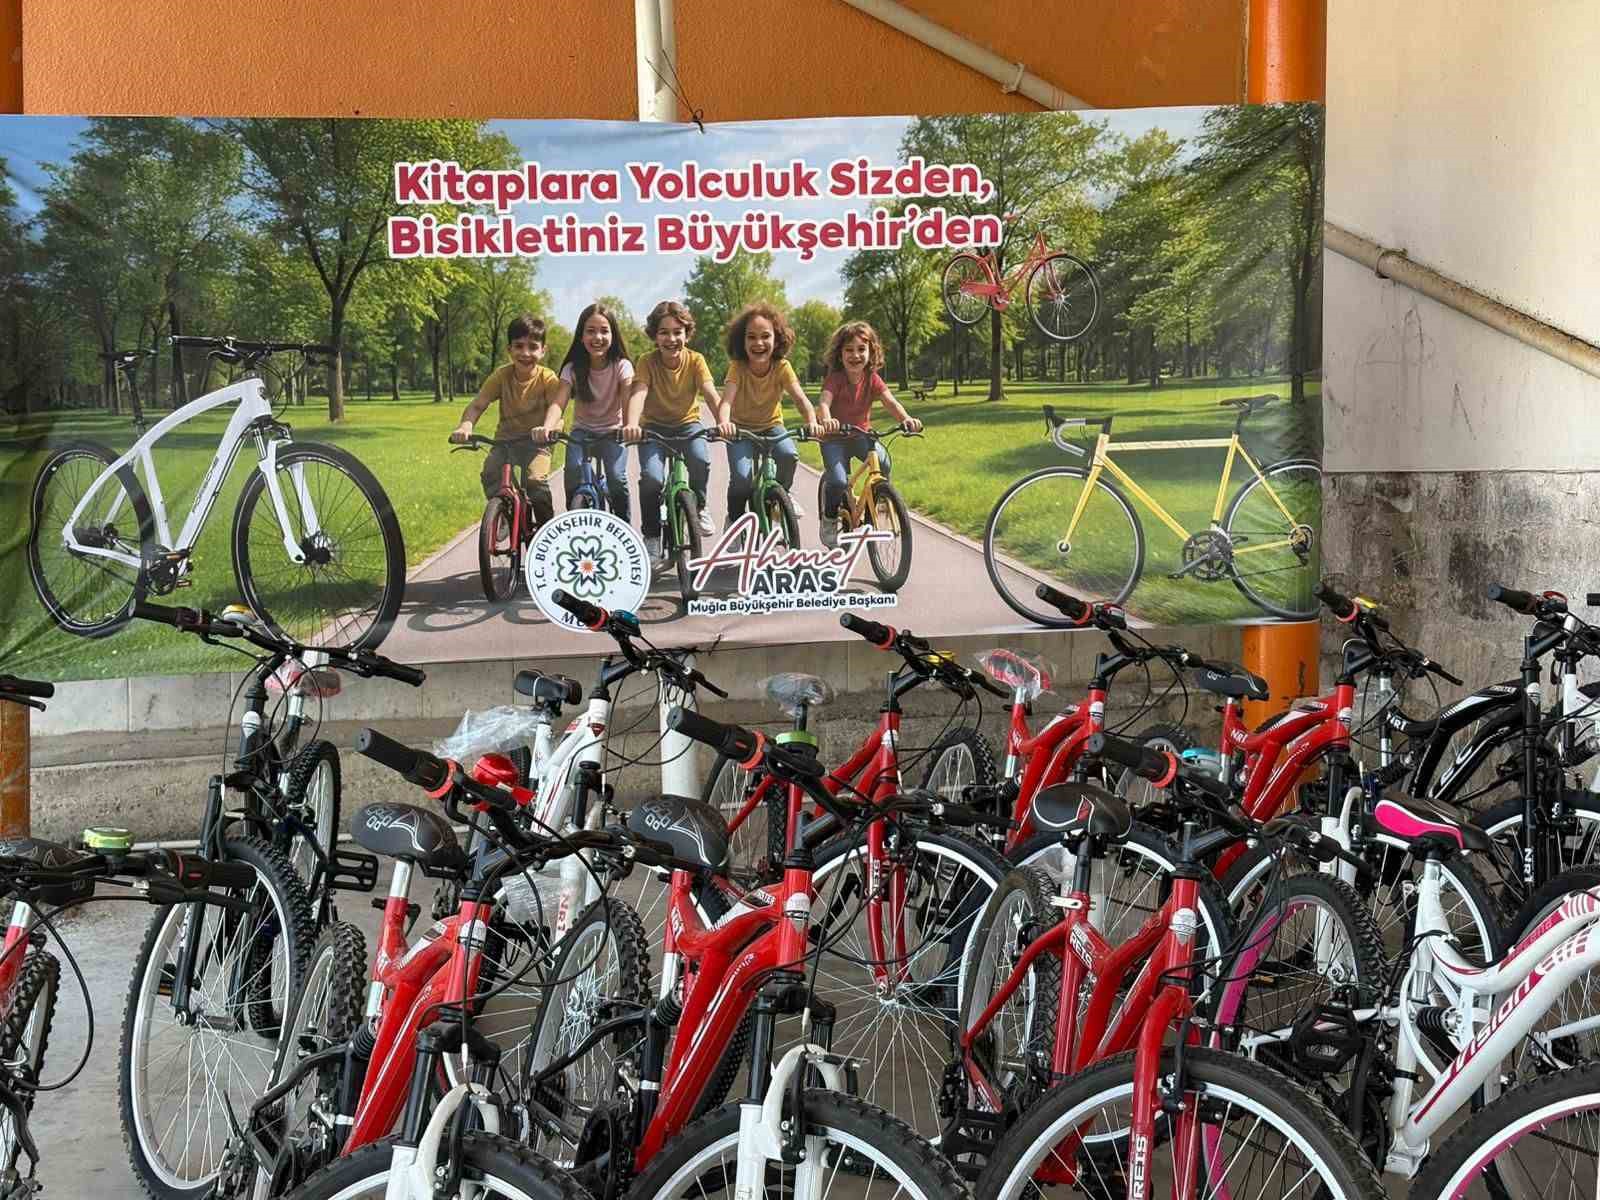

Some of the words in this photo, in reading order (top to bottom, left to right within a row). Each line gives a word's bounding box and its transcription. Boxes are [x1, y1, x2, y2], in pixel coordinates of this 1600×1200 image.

[397, 161, 619, 210] Kitaplara
[629, 160, 818, 199] Yolculuk
[829, 158, 991, 197] Sizden,
[391, 215, 645, 255] Bisikletiniz
[688, 513, 891, 593] Ahmet
[751, 570, 838, 596] ARAS
[690, 601, 727, 614] Muğla
[729, 598, 794, 613] Büyükşehir
[796, 597, 846, 609] Belediye
[849, 595, 896, 608] Başkanı
